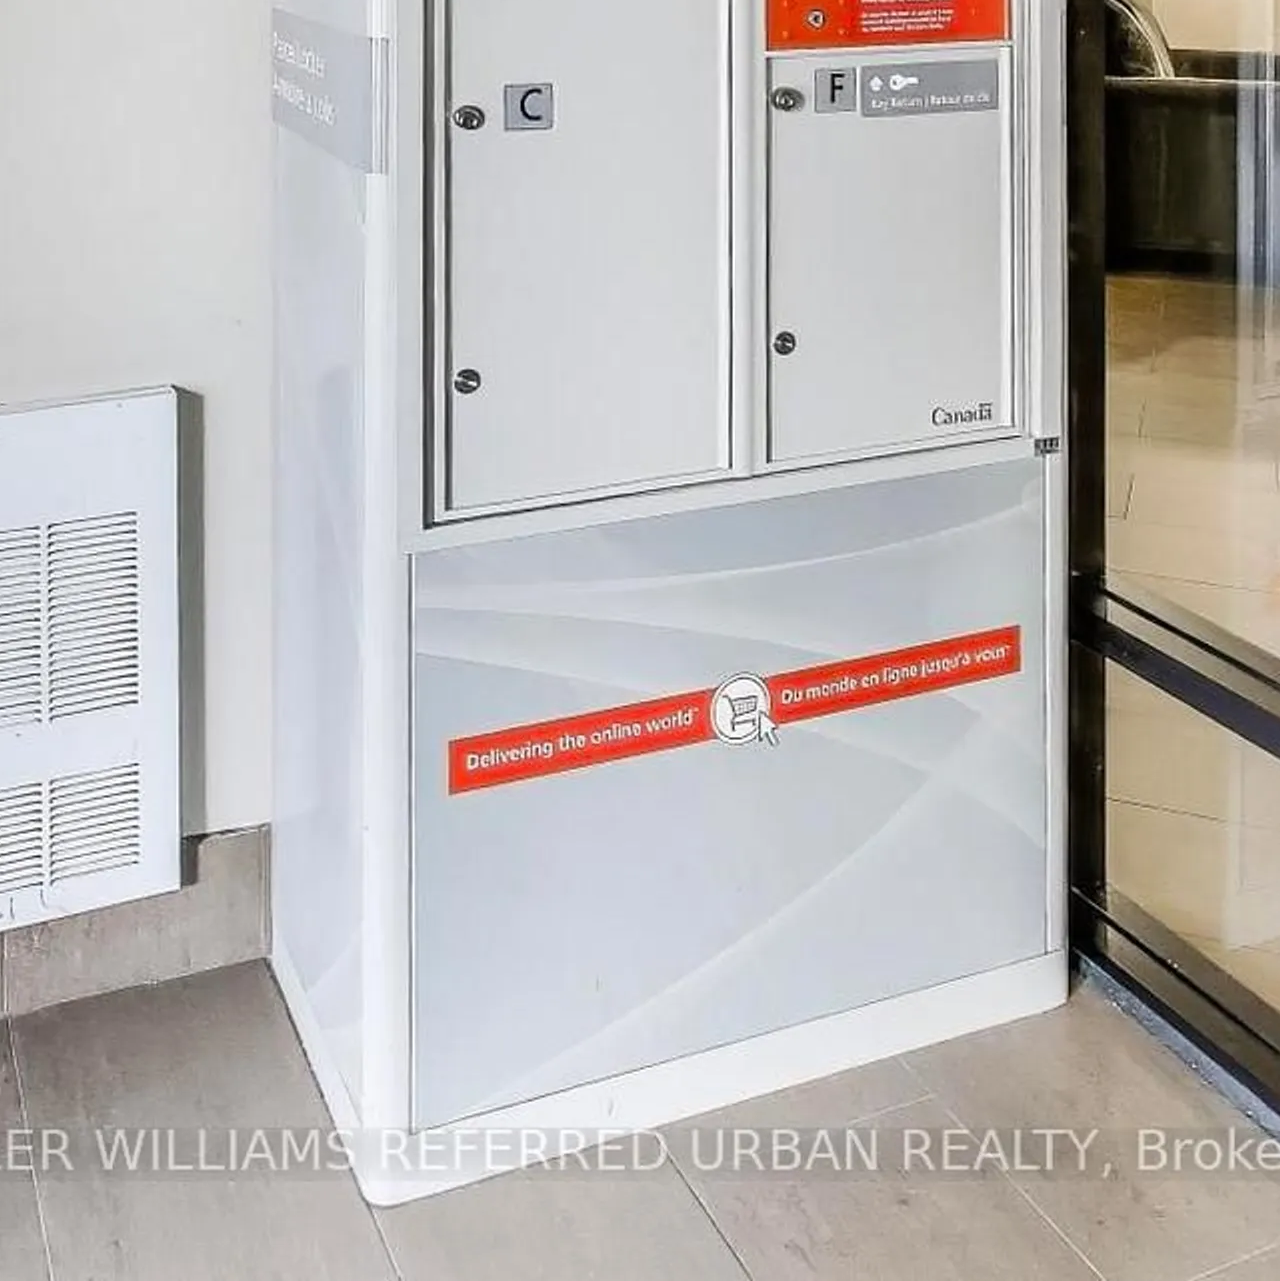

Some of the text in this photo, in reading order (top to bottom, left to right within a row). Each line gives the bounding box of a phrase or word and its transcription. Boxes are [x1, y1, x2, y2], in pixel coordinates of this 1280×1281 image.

[519, 88, 543, 121] C
[830, 72, 846, 104] F
[931, 403, 993, 426] Canada
[781, 687, 803, 705] Du
[806, 675, 858, 699] monde
[861, 674, 880, 688] en
[882, 664, 918, 686] ligne
[466, 708, 694, 771] Delivering the online world
